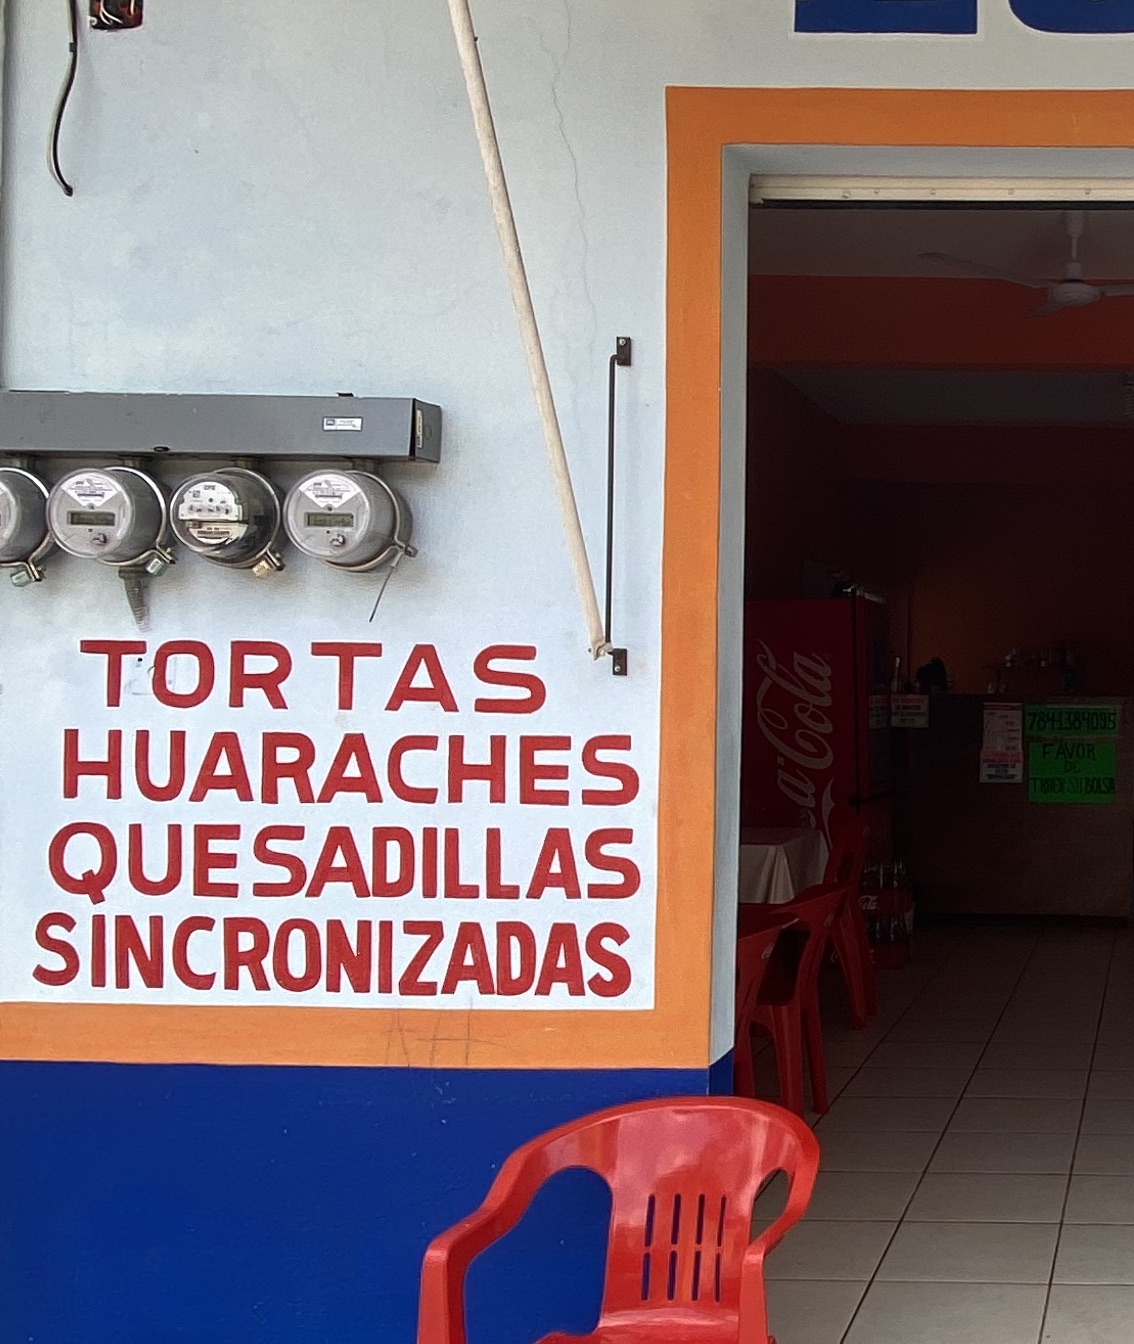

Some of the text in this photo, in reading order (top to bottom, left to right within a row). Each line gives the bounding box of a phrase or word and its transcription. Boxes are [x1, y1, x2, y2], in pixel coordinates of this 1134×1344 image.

[80, 639, 547, 714] TORTAS
[62, 728, 640, 806] HUARACHES
[1041, 742, 1098, 761] FAVOR
[1062, 760, 1081, 773] DE
[48, 821, 641, 905] QUESADILLAS
[32, 912, 633, 998] SINCRONIZADAS
